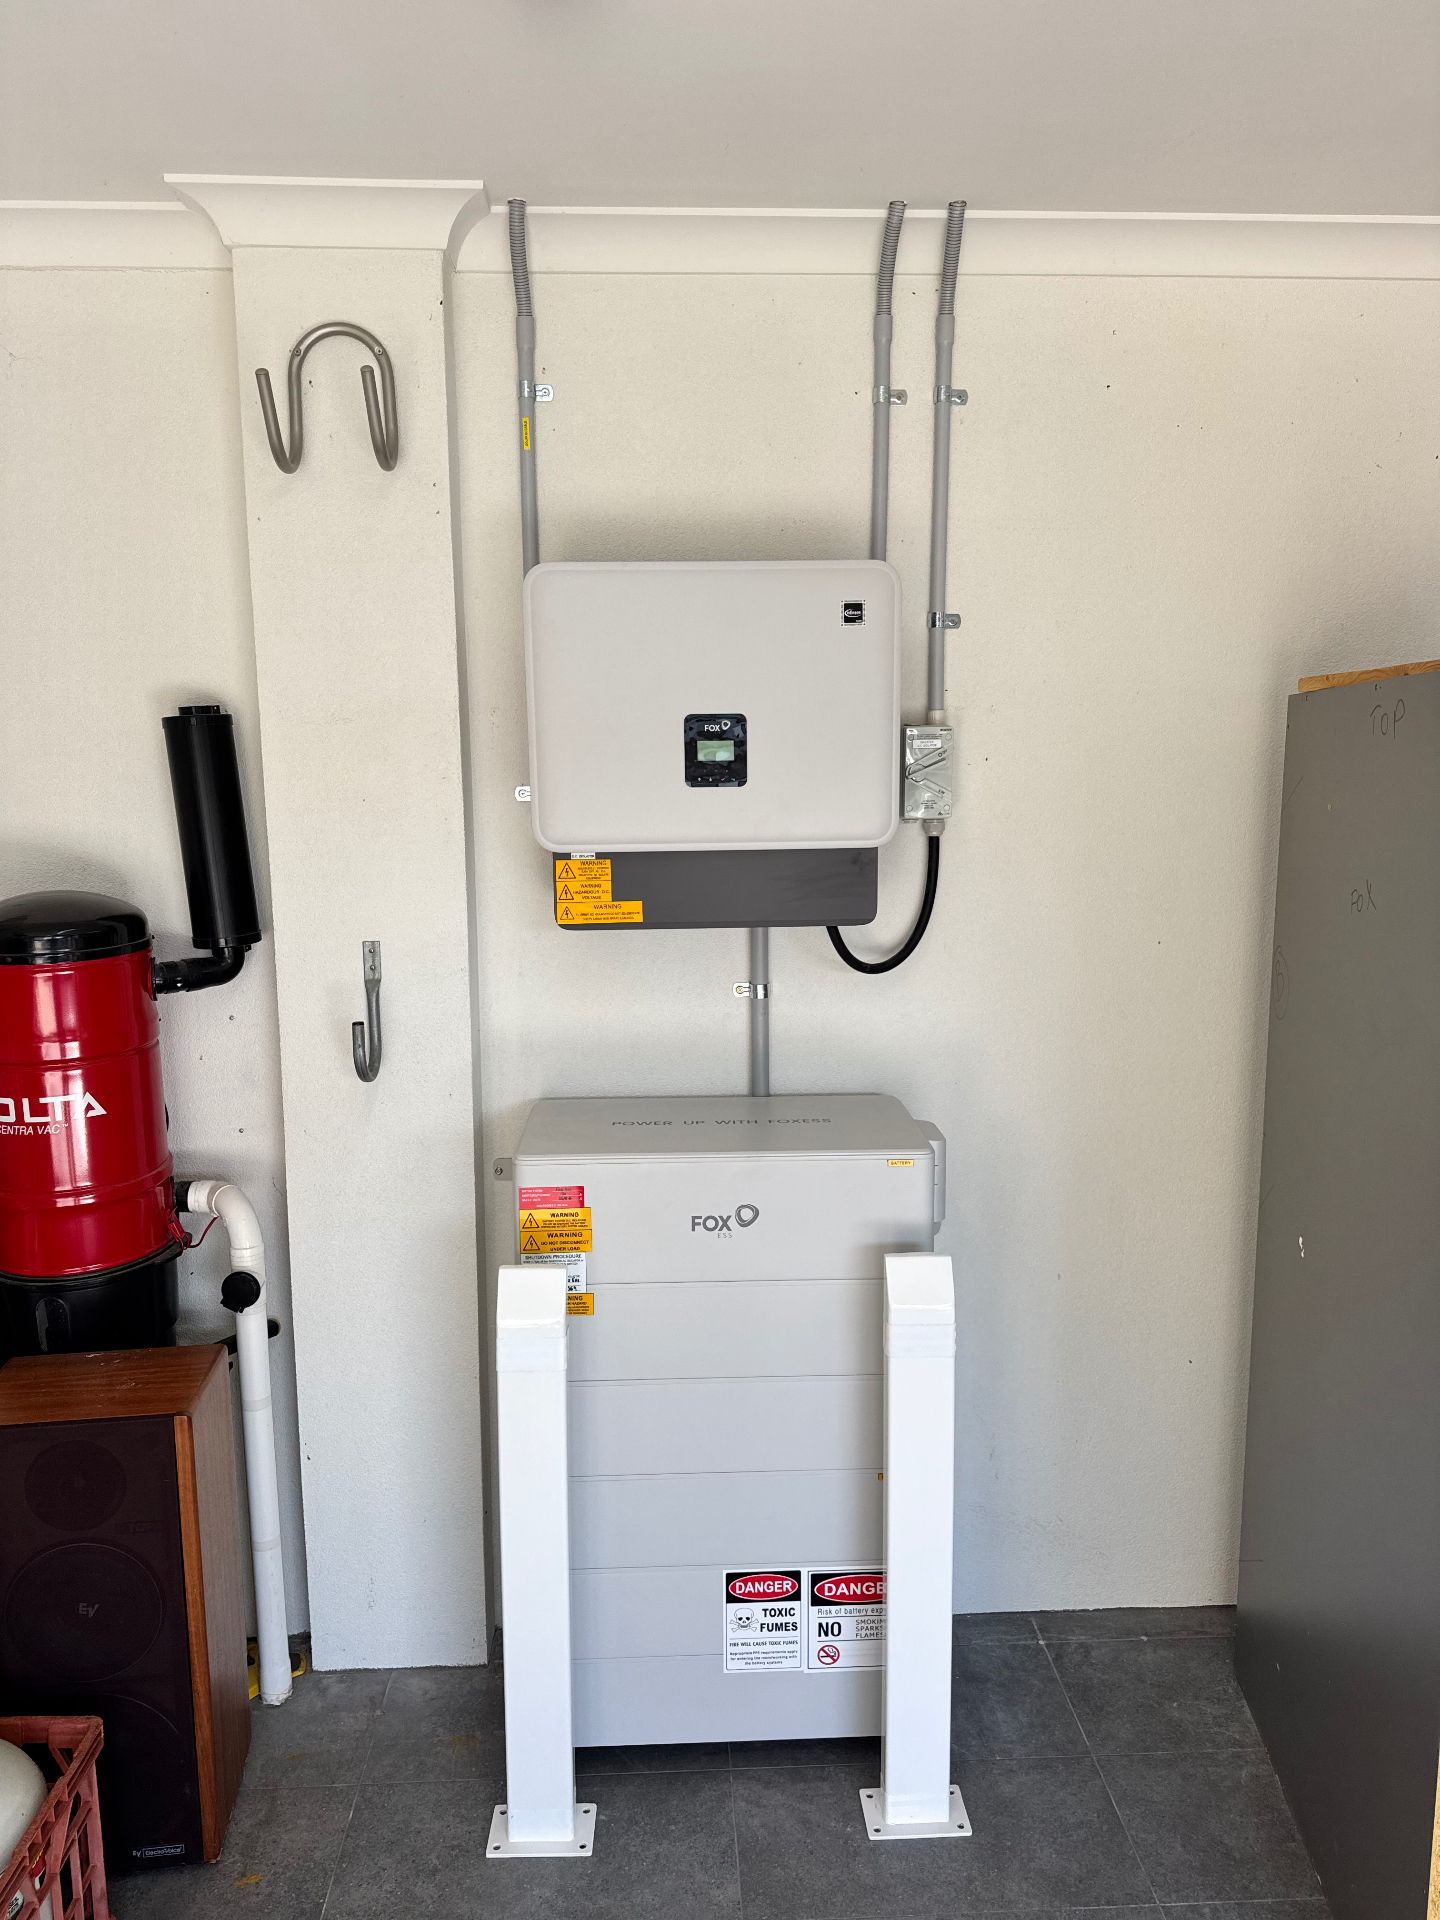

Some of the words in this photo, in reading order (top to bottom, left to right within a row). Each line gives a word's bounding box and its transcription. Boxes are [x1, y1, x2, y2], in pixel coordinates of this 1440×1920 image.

[1370, 699, 1405, 738] TOP
[0, 1092, 107, 1122] OLTA
[692, 1215, 732, 1232] FOX
[736, 1581, 792, 1594] DANGER
[824, 1582, 886, 1596] DANGE
[762, 1608, 796, 1618] TOXIC
[844, 1608, 869, 1616] battery
[760, 1622, 798, 1632] FUMES
[818, 1622, 842, 1637] NO
